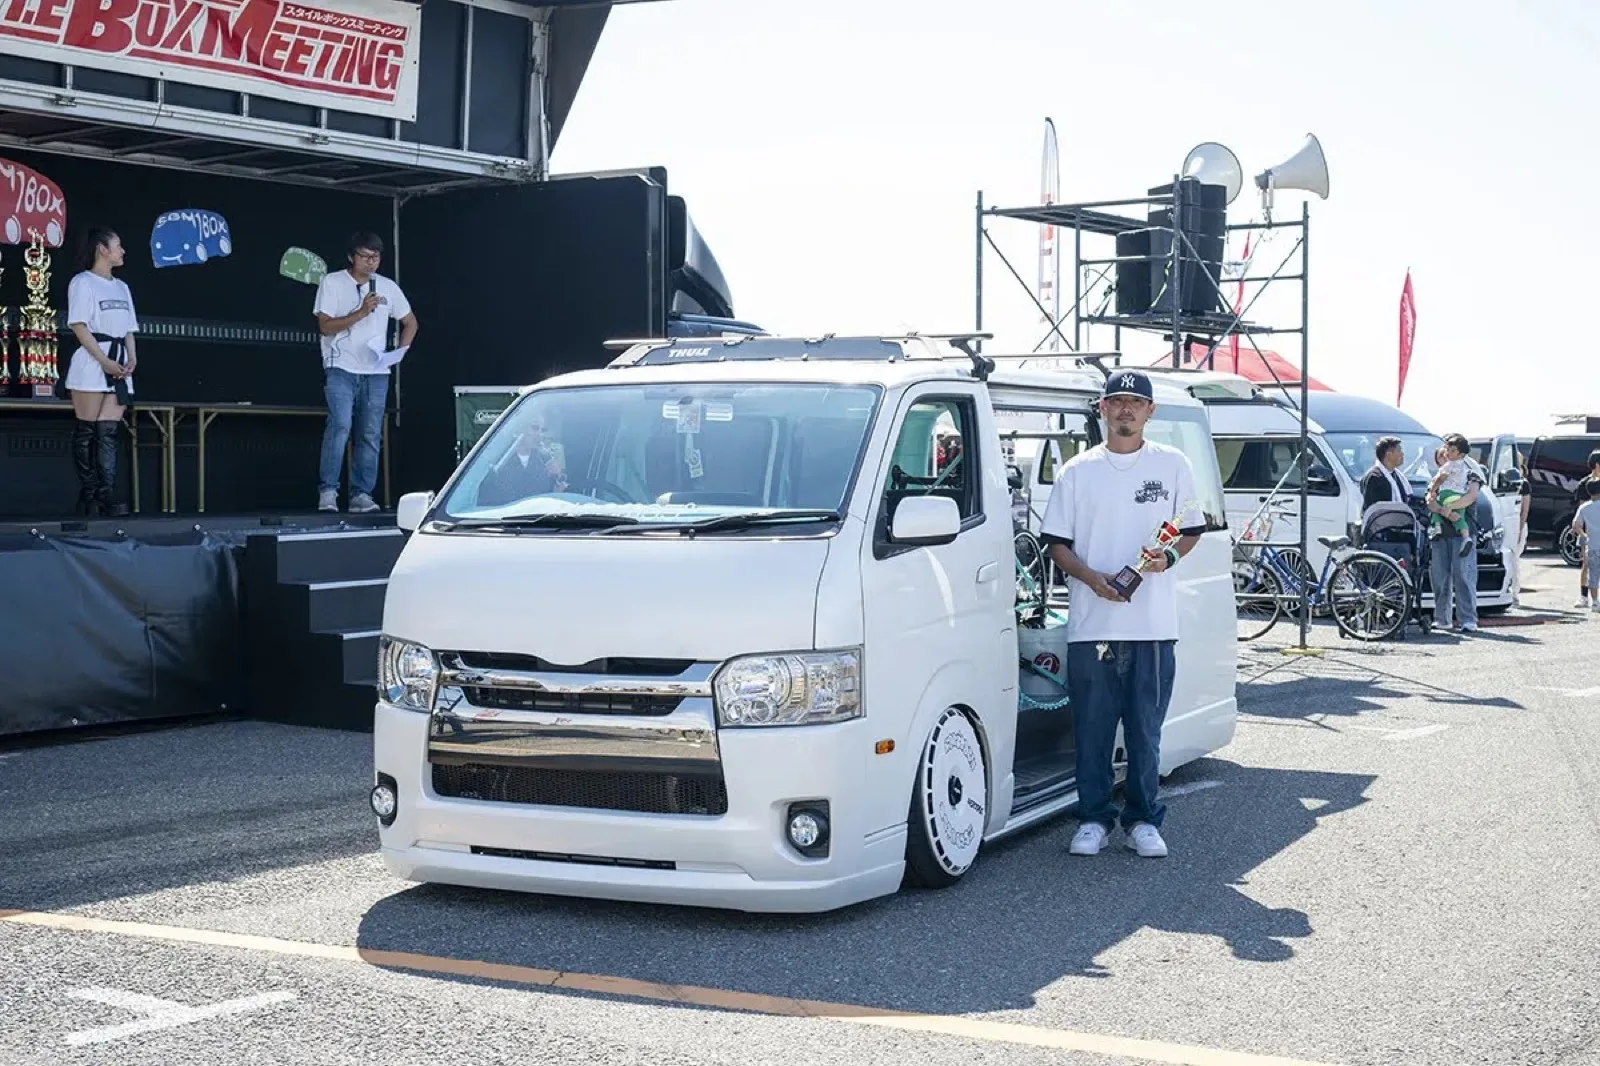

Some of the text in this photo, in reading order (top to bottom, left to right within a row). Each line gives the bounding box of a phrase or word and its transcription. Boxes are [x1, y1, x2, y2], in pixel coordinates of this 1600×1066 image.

[285, 5, 404, 38] スタイルボックスミーティング
[199, 0, 405, 90] MEETING
[668, 347, 712, 358] THULE
